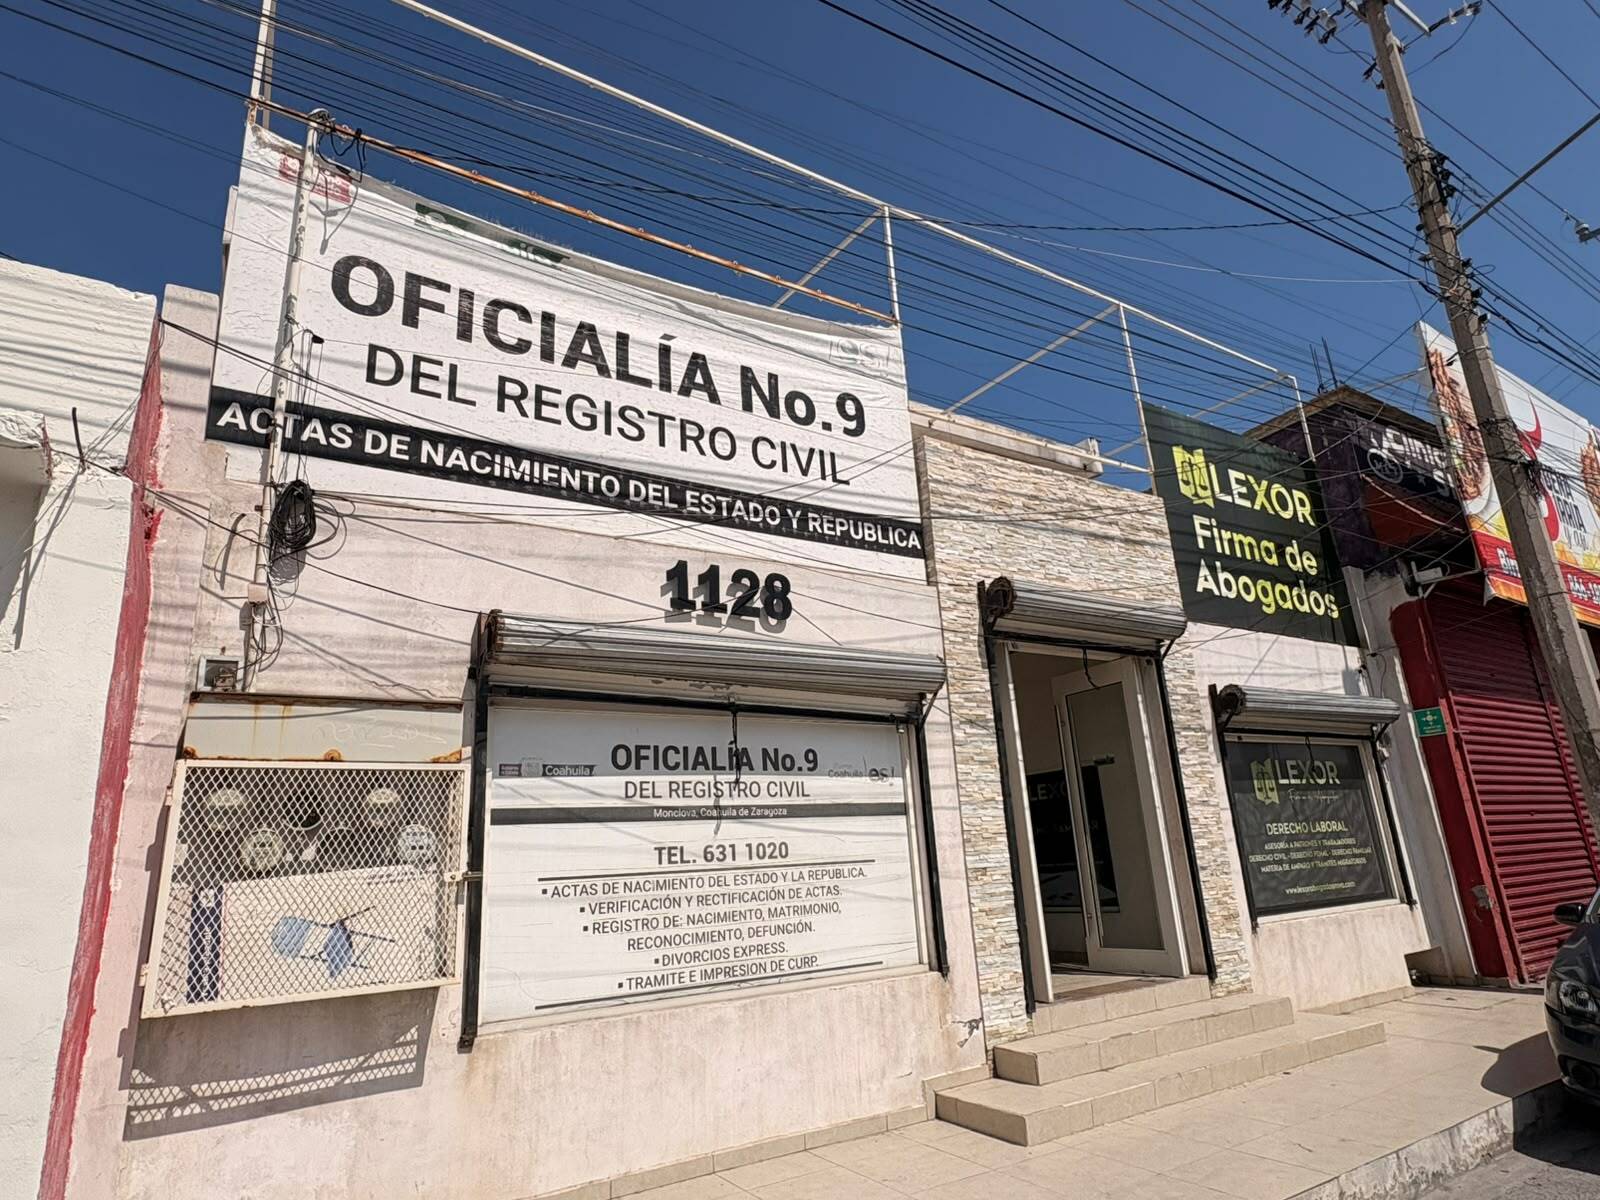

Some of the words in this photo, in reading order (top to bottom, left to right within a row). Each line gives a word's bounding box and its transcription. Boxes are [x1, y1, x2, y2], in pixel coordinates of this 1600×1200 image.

[331, 255, 722, 406] OFICIALÍA
[740, 365, 867, 438] No.9
[365, 343, 477, 407] DEL
[496, 373, 738, 462] REGISTRO
[751, 435, 851, 486] CIVIL
[215, 402, 354, 449] ACTAS
[364, 430, 411, 461] DE
[419, 439, 621, 498] NACIMIENTO
[628, 479, 679, 510] DEL
[686, 490, 781, 527] ESTADO
[785, 508, 802, 530] Y
[808, 511, 922, 550] REPUBLICA
[1208, 460, 1316, 527] LEXOR
[1192, 514, 1279, 567] Firma
[1285, 539, 1318, 576] de
[665, 559, 793, 621] 1128
[1196, 558, 1340, 619] Abogados
[545, 765, 591, 776] Coahuila
[610, 739, 755, 771] OFICIALÍA
[762, 747, 819, 772] No.9
[1275, 759, 1341, 785] LEXOR
[624, 780, 663, 799] DEL
[668, 780, 761, 798] REGISTRO
[766, 780, 810, 798] CIVIL
[738, 807, 749, 816] de
[750, 806, 788, 817] Zaragoza
[1266, 822, 1309, 835] DERECHO
[1310, 820, 1349, 833] LABORAL
[654, 846, 697, 866] TEL.
[703, 844, 737, 863] 631
[745, 841, 789, 861] 1020
[551, 883, 599, 898] ACTAS
[602, 882, 620, 895] DE
[623, 877, 705, 893] NACIMIENTO
[708, 876, 731, 888] DEL
[734, 872, 779, 886] ESTADO
[781, 871, 789, 882] Y
[791, 870, 805, 882] LA
[588, 894, 681, 915] VERIFICACIÓN
[685, 896, 694, 907] Y
[697, 887, 785, 907] RECTIFICACIÓN
[788, 888, 802, 899] DE
[592, 917, 659, 934] REGISTRO
[686, 908, 765, 926] NACIMIENTO,
[768, 901, 842, 918] MATRIMONIO,
[627, 928, 745, 951] RECONOCIMIENTO,
[747, 920, 815, 939] DEFUNCIÓN.
[662, 947, 730, 966] DIVORCIOS
[733, 941, 788, 958] EXPRESS.
[626, 970, 685, 990] TRAMITE
[689, 970, 697, 982] E
[700, 962, 767, 981] IMPRESION
[770, 960, 785, 973] DE
